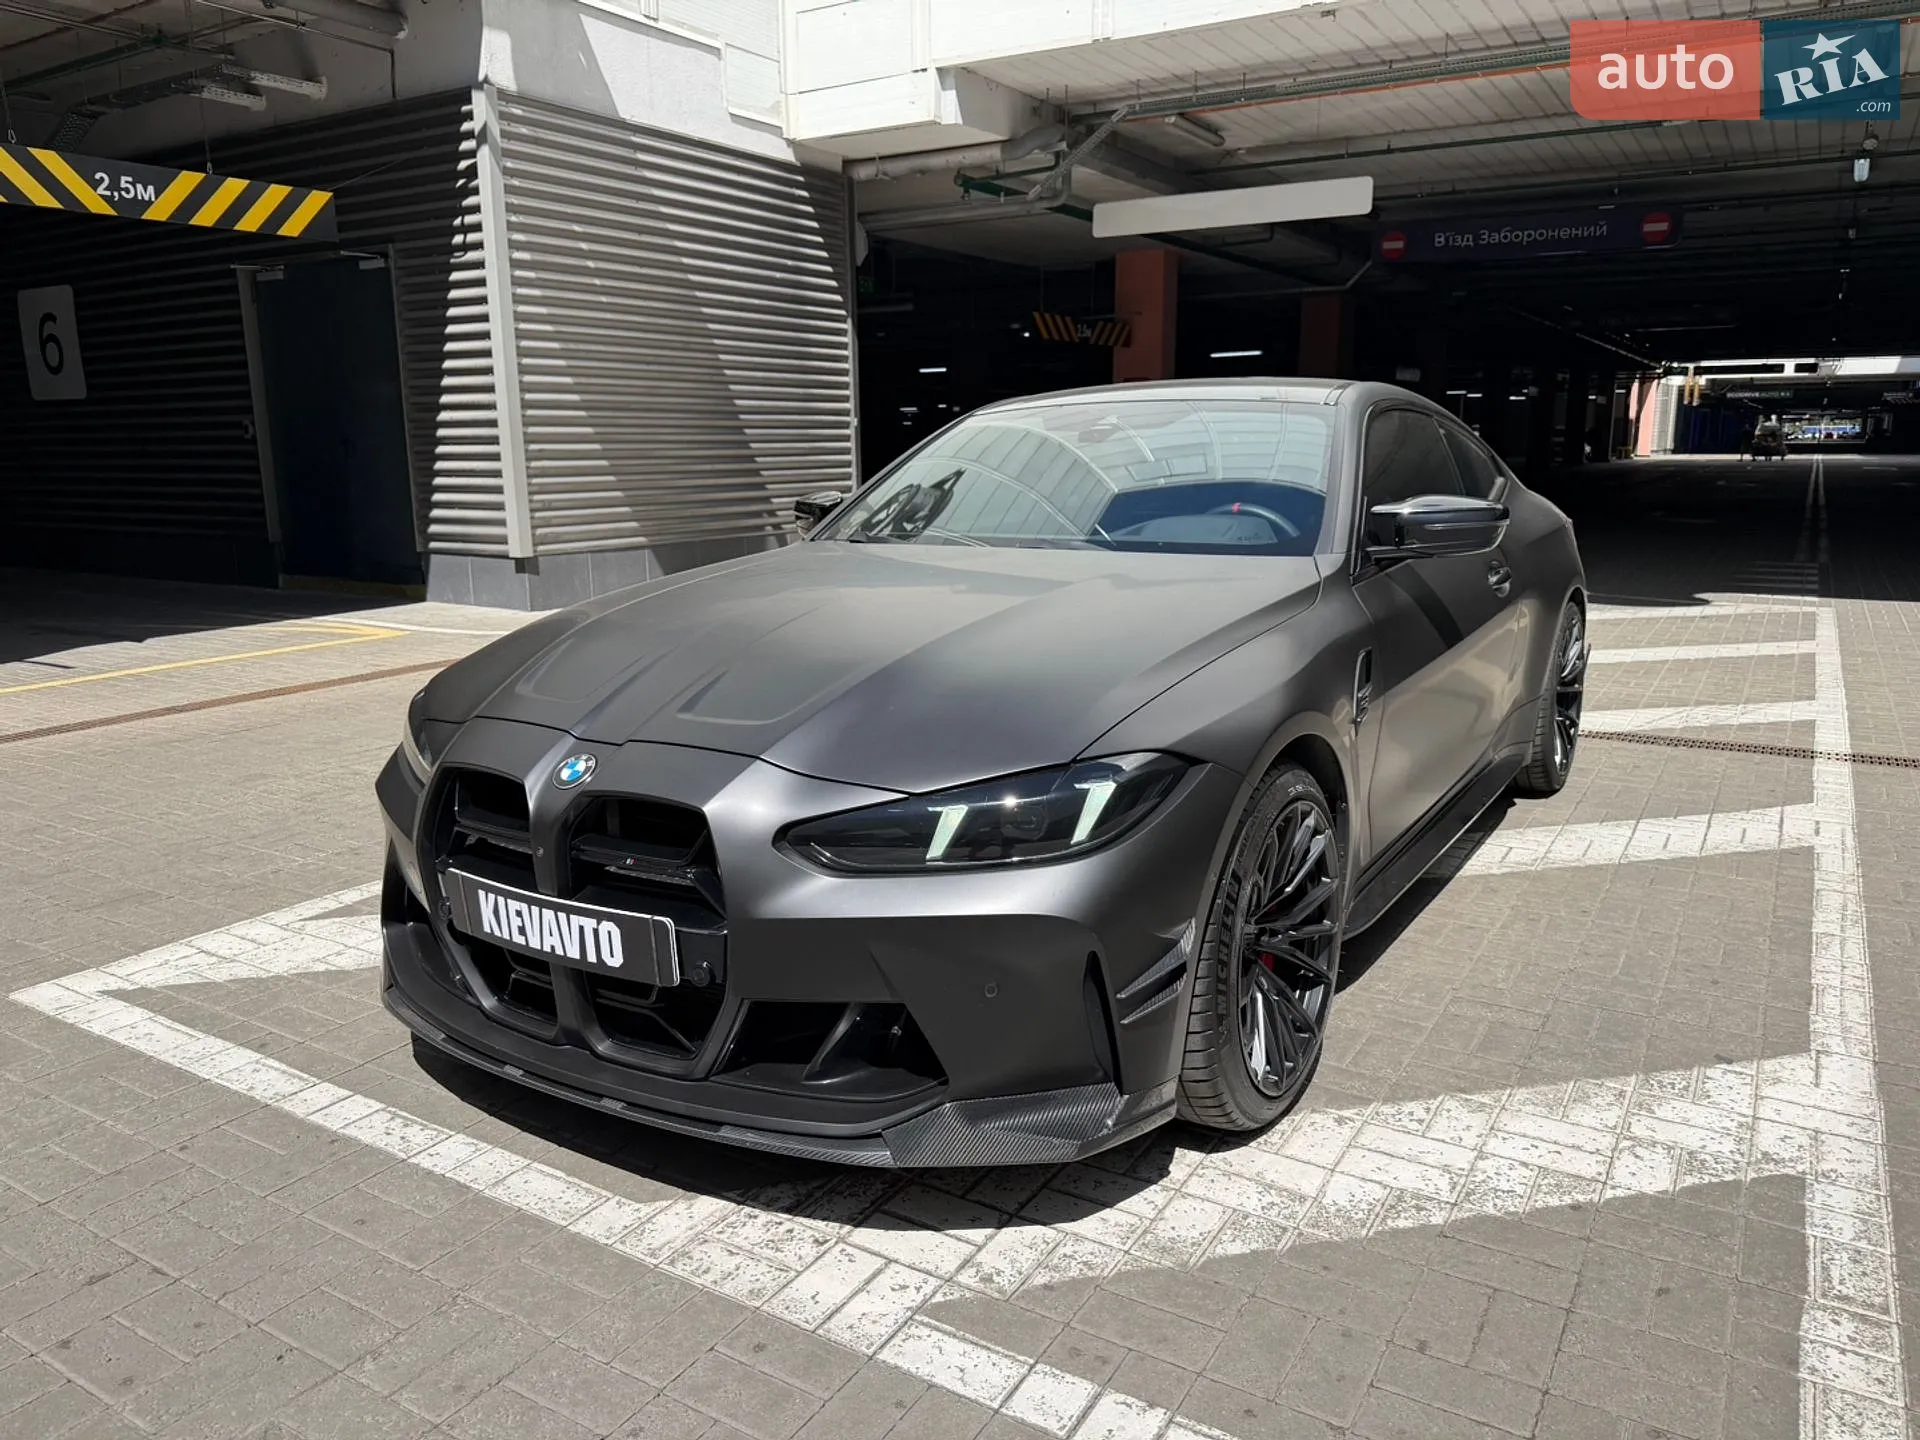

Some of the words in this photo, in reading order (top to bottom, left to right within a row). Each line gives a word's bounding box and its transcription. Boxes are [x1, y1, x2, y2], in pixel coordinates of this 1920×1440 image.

[1478, 220, 1608, 246] Заборонений
[38, 312, 65, 376] 6
[477, 889, 624, 968] KIEVAVTO
